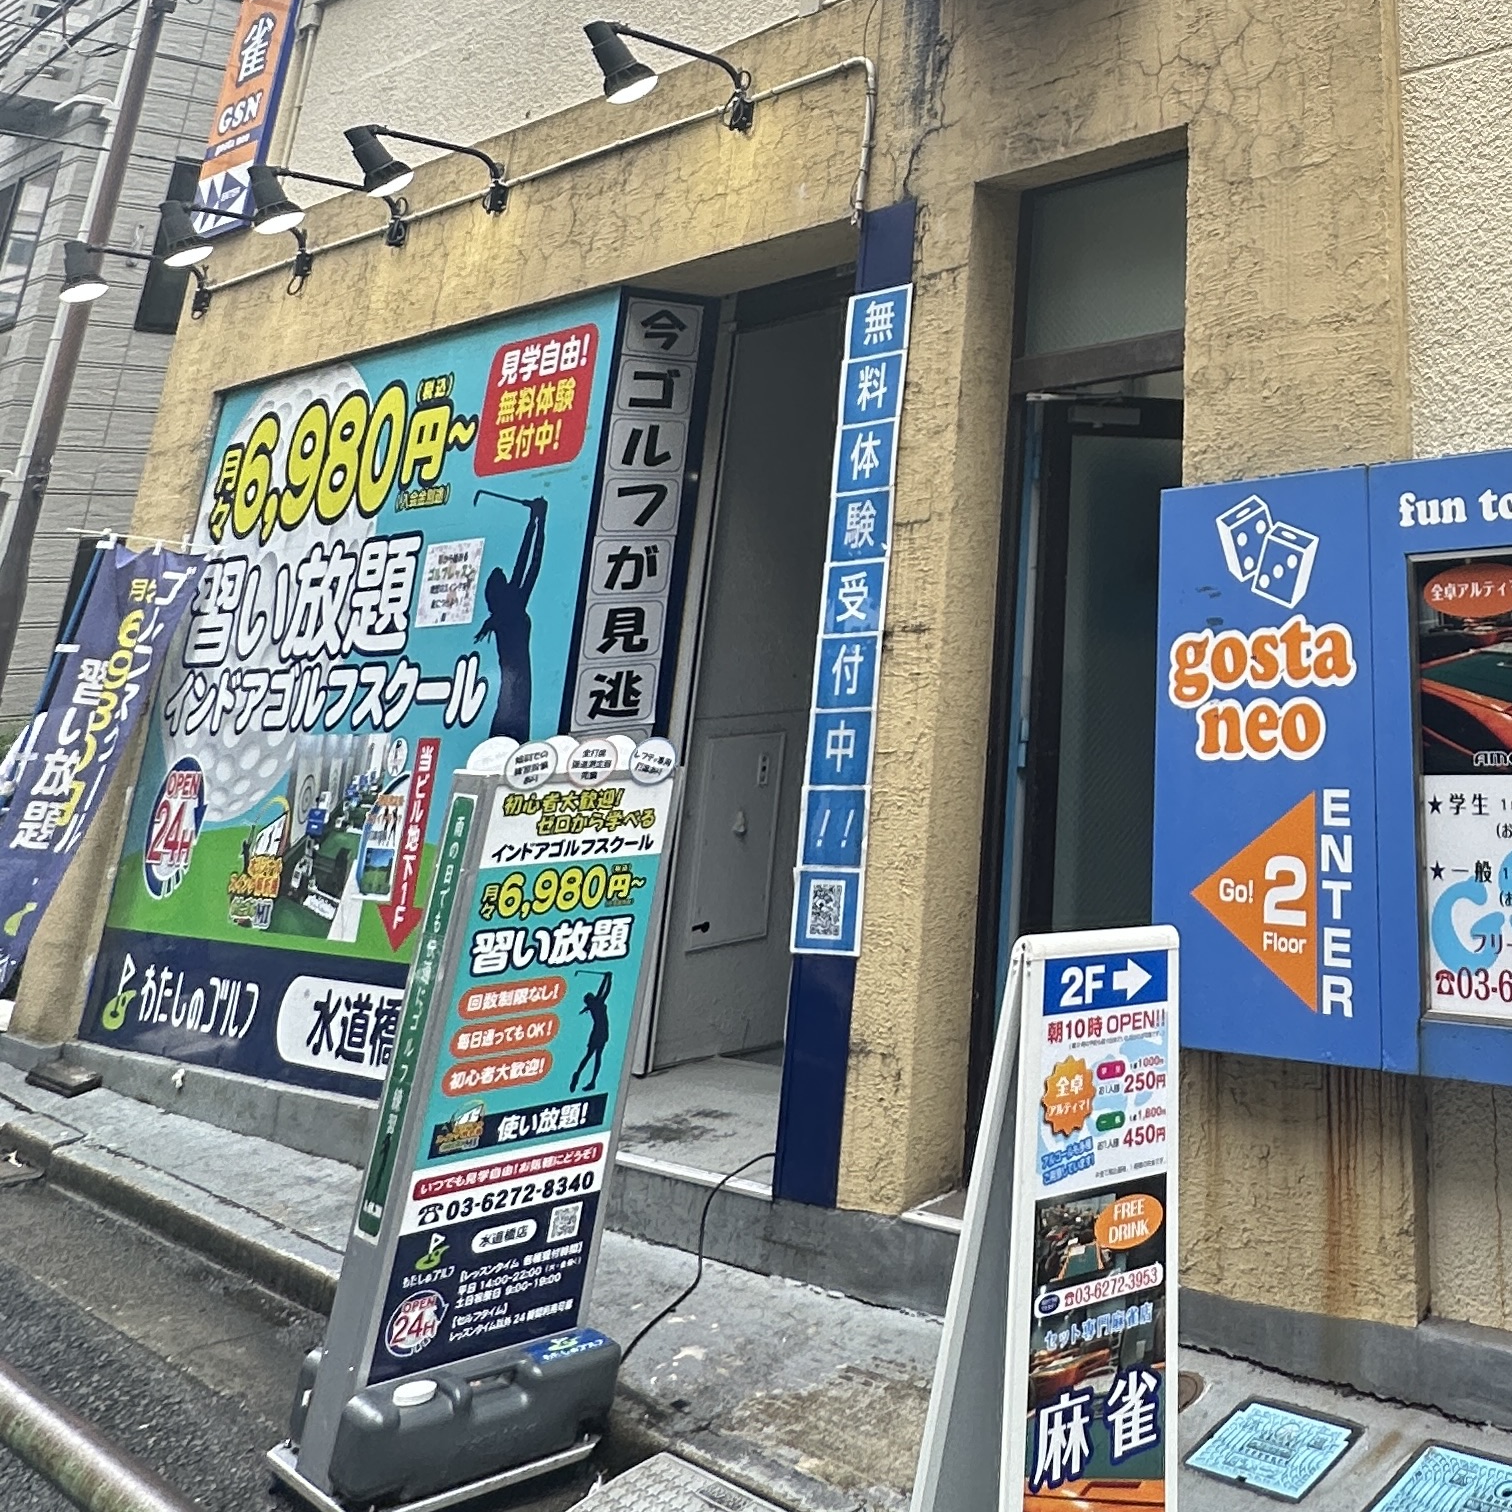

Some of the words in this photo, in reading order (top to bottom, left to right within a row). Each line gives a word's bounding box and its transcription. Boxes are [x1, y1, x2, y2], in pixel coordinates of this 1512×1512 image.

[238, 15, 275, 84] 雀
[218, 89, 263, 135] GSN
[497, 333, 591, 386] 見学自由!
[495, 376, 577, 425] 無料体験
[493, 419, 562, 463] 受付中!
[1398, 491, 1468, 528] fun
[184, 532, 422, 667] 習い放題
[1170, 615, 1356, 707] gosta
[165, 651, 487, 735] インドアゴルフスクール
[1198, 698, 1325, 760] neo
[166, 770, 201, 799] OPEN
[146, 801, 194, 865] 24H
[492, 834, 654, 863] インドアゴルフスクール
[1218, 877, 1255, 905] Go!
[1262, 855, 1308, 927] 2
[1321, 788, 1353, 1018] ENTER
[470, 914, 635, 977] 習い放題
[1262, 931, 1307, 954] Floor
[139, 964, 259, 1038] わたしのゴルフ
[1060, 965, 1105, 1007] 2F
[1056, 1074, 1084, 1098] 全卓
[497, 1102, 588, 1143] 使い放題!
[446, 1171, 595, 1221] 03-6272-8340
[1113, 1198, 1145, 1221] FREE
[1108, 1221, 1150, 1244] DRINK
[1075, 1267, 1158, 1304] 03-6272-3953
[390, 1311, 436, 1346] 24H
[1031, 1368, 1160, 1489] 麻雀
